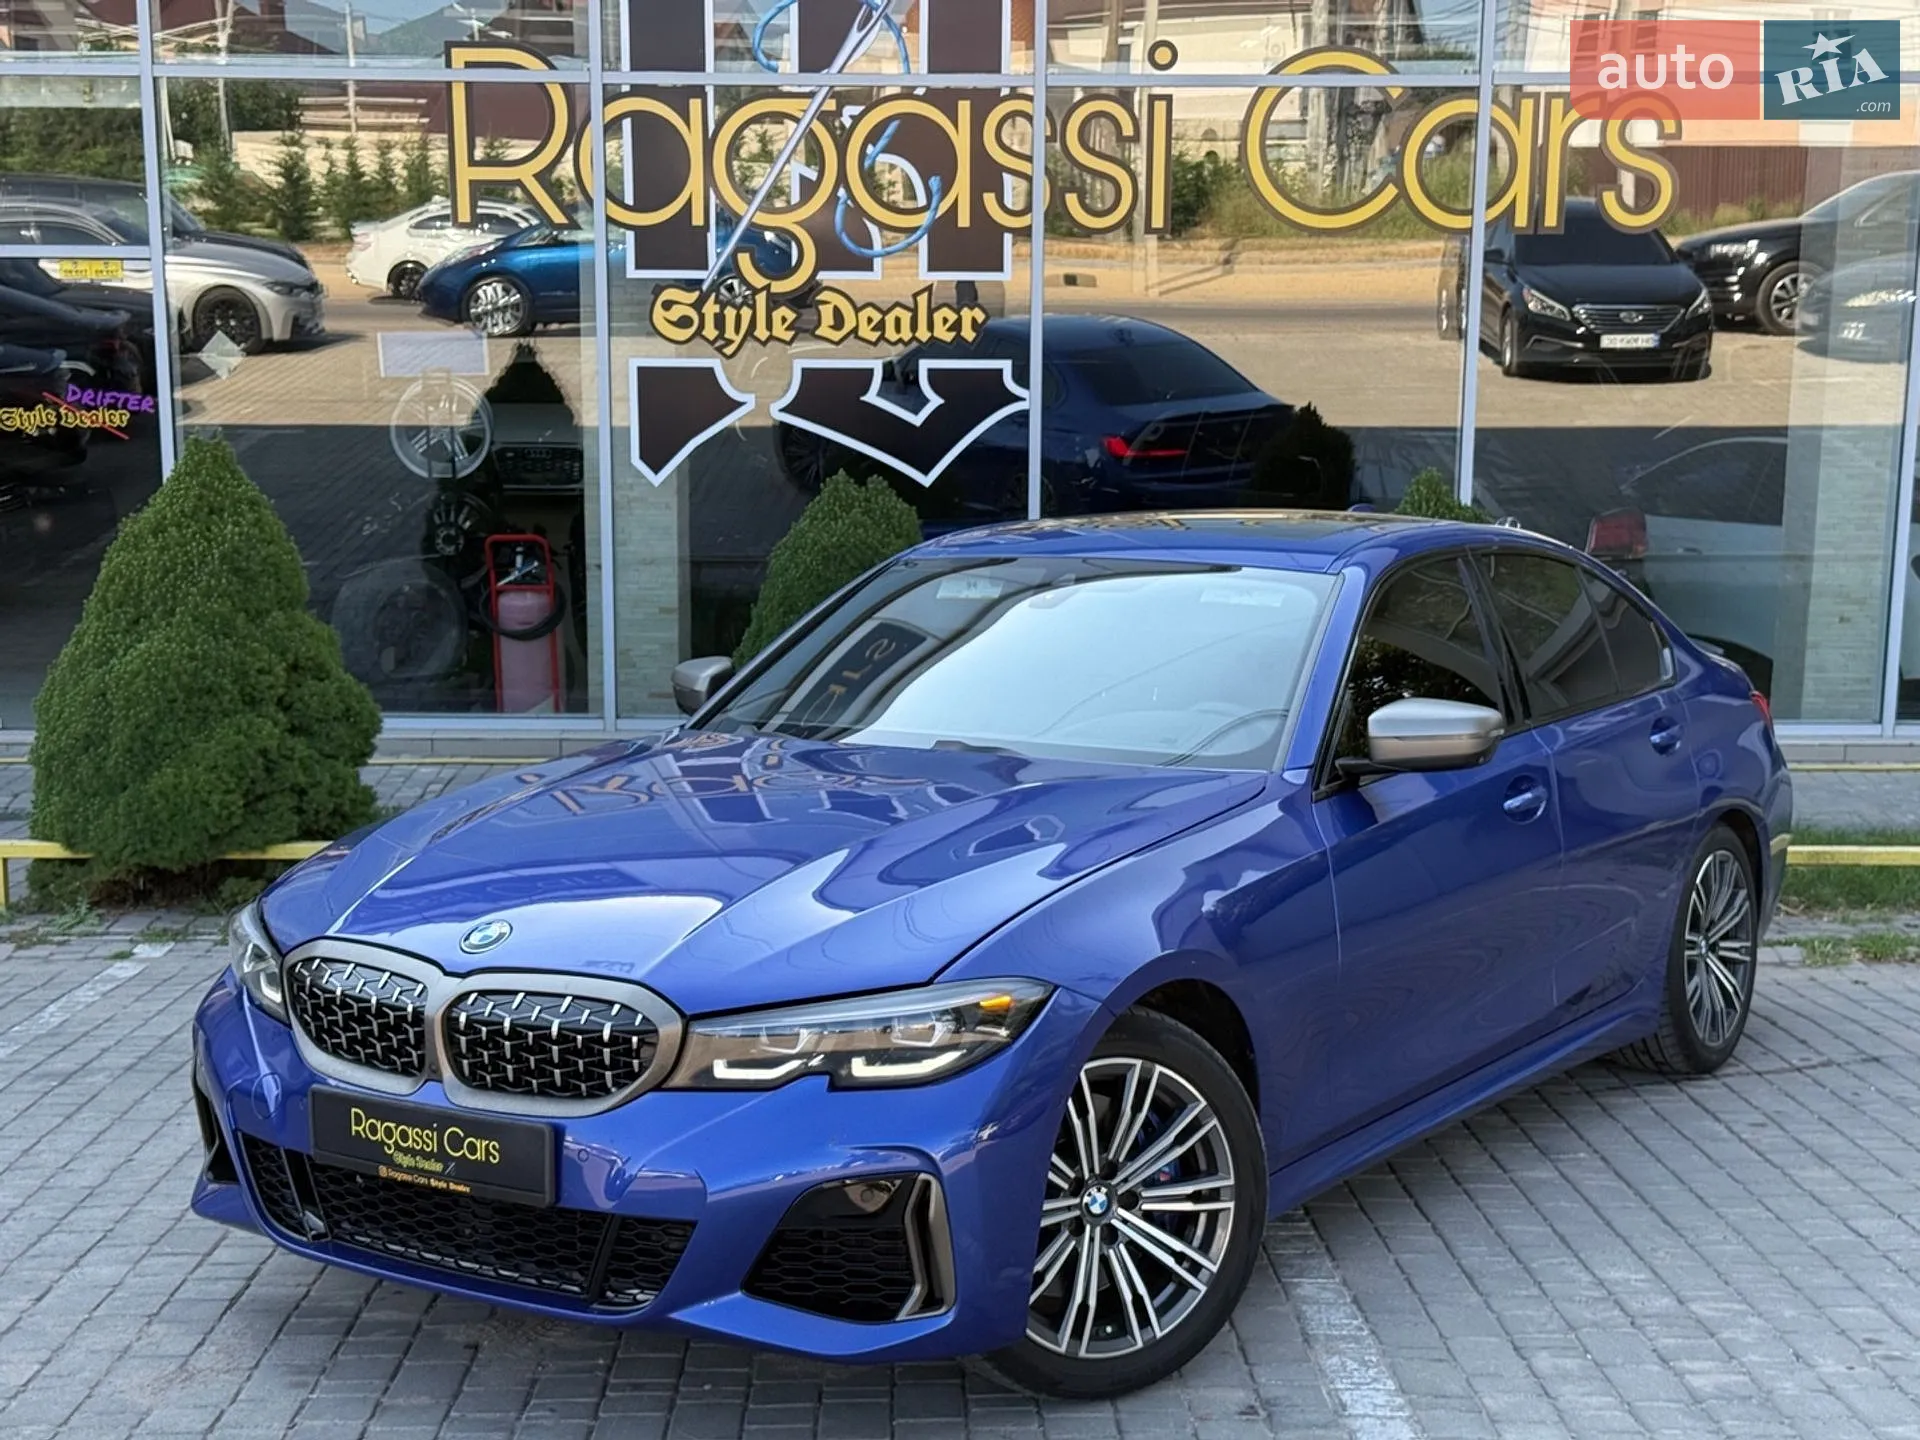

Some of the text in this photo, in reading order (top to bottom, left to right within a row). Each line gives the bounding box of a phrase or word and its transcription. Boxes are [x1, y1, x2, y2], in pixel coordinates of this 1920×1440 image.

[447, 39, 1683, 296] Ragassi Cars
[651, 282, 990, 360] Style Dealer
[0, 404, 130, 433] Style Dealer
[66, 384, 156, 413] DRIFTER
[351, 1107, 500, 1164] Ragassi Cars
